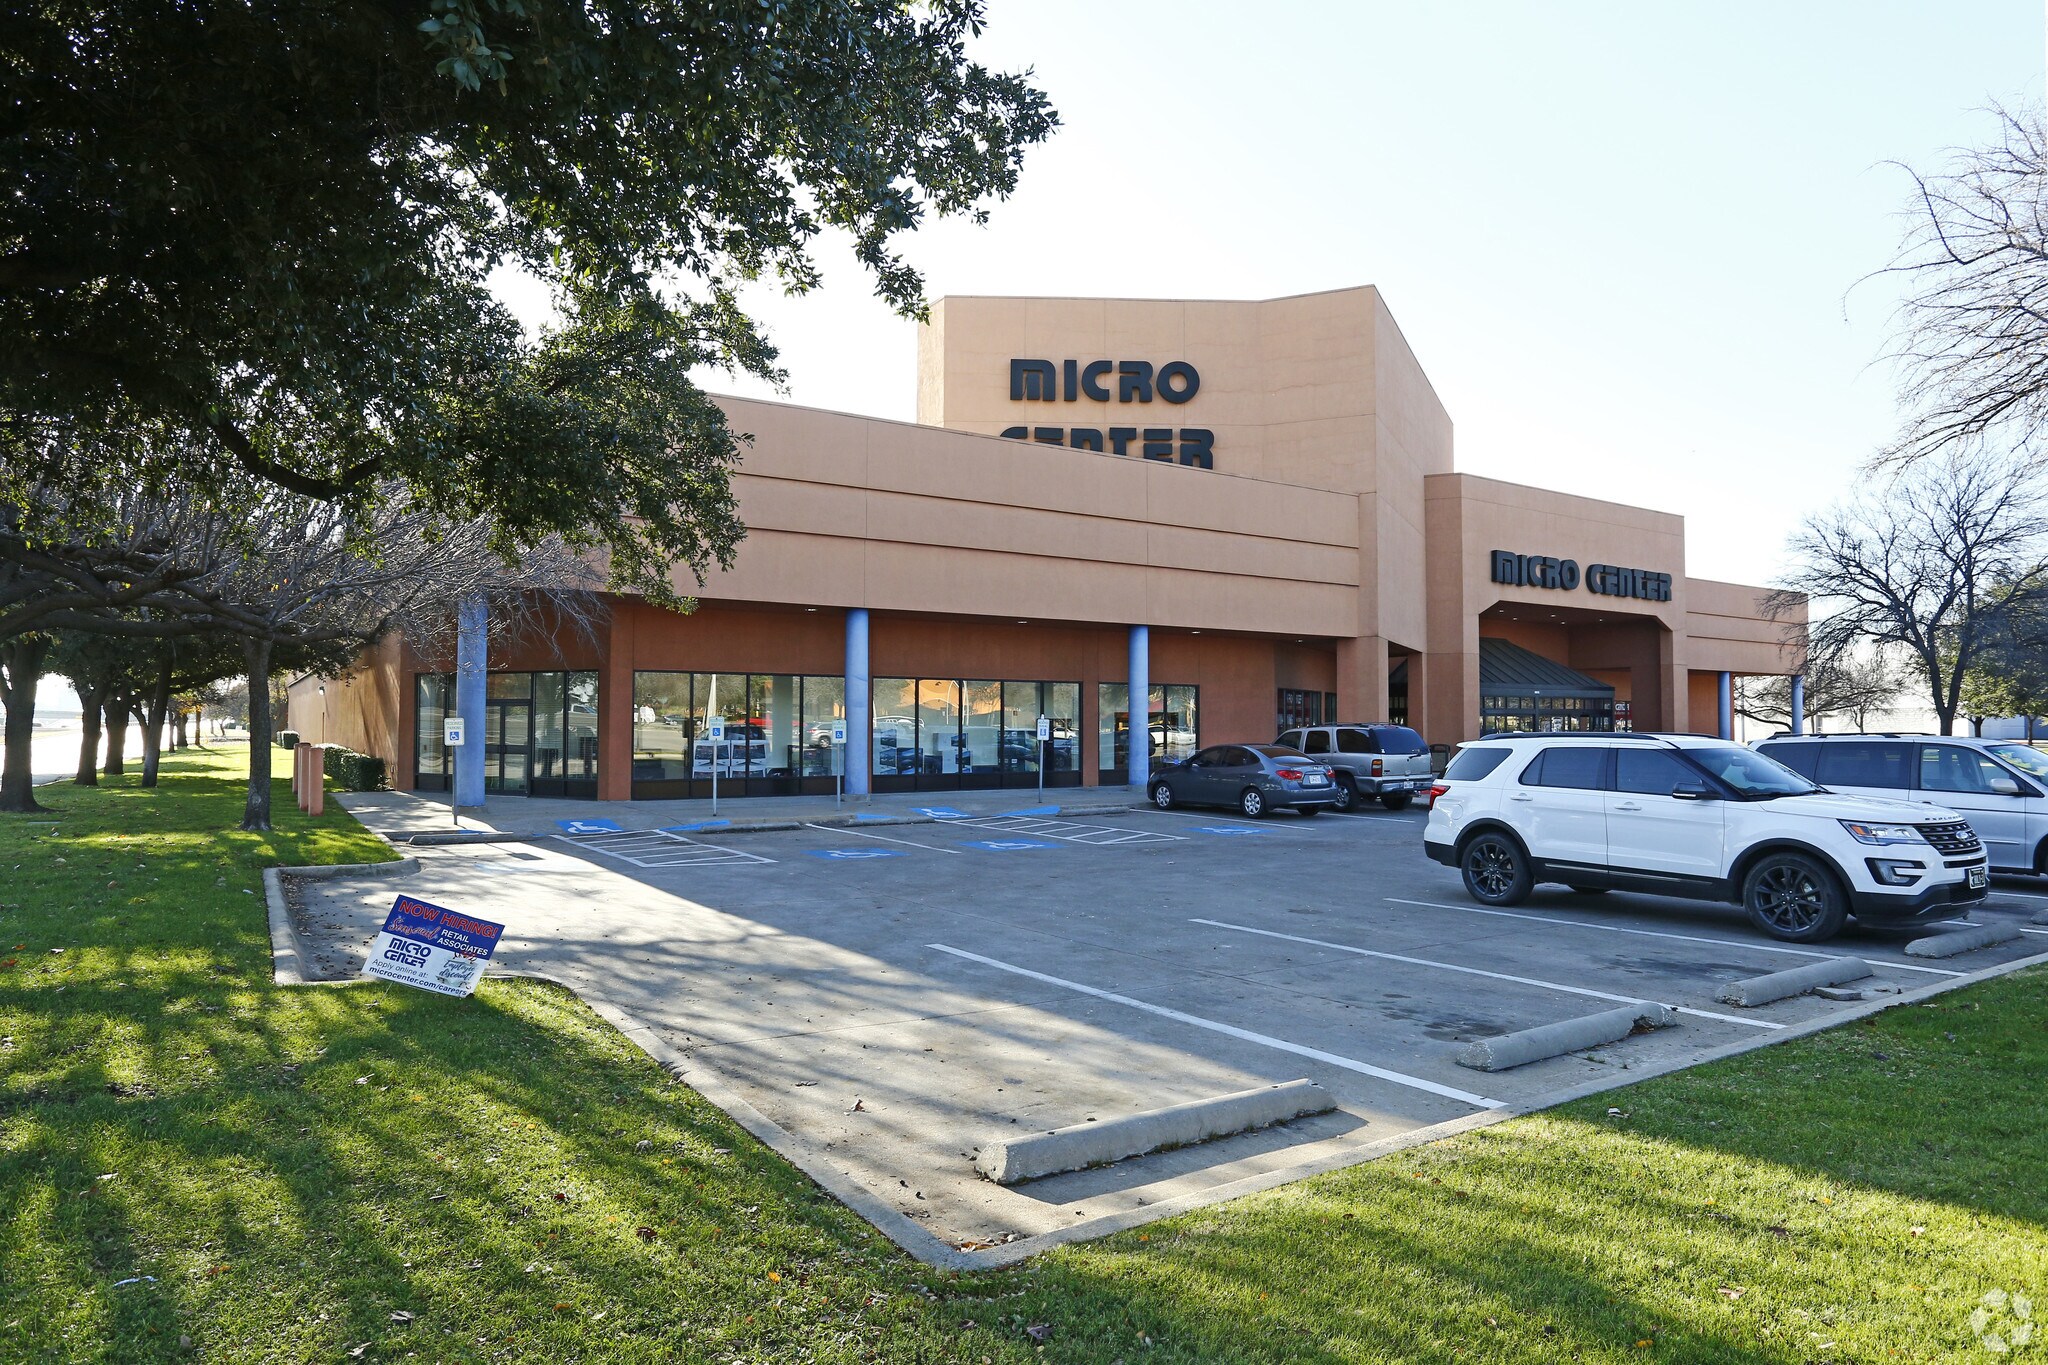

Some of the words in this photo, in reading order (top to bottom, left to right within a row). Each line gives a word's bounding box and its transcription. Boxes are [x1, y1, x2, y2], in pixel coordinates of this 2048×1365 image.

[1010, 359, 1200, 404] MICRO
[1491, 550, 1580, 590] MICRO
[1585, 564, 1672, 601] CENTER
[399, 901, 440, 920] NOW
[441, 913, 498, 938] HIRING!
[441, 929, 469, 943] RETAIL
[389, 937, 431, 957] MICRO
[437, 937, 488, 956] ASSOCIATES
[384, 949, 426, 968] CENTER
[443, 960, 476, 972] Employee
[372, 959, 394, 970] Apply
[395, 966, 417, 976] online
[418, 971, 429, 979] at:
[368, 967, 467, 996] microcenter.com/careers
